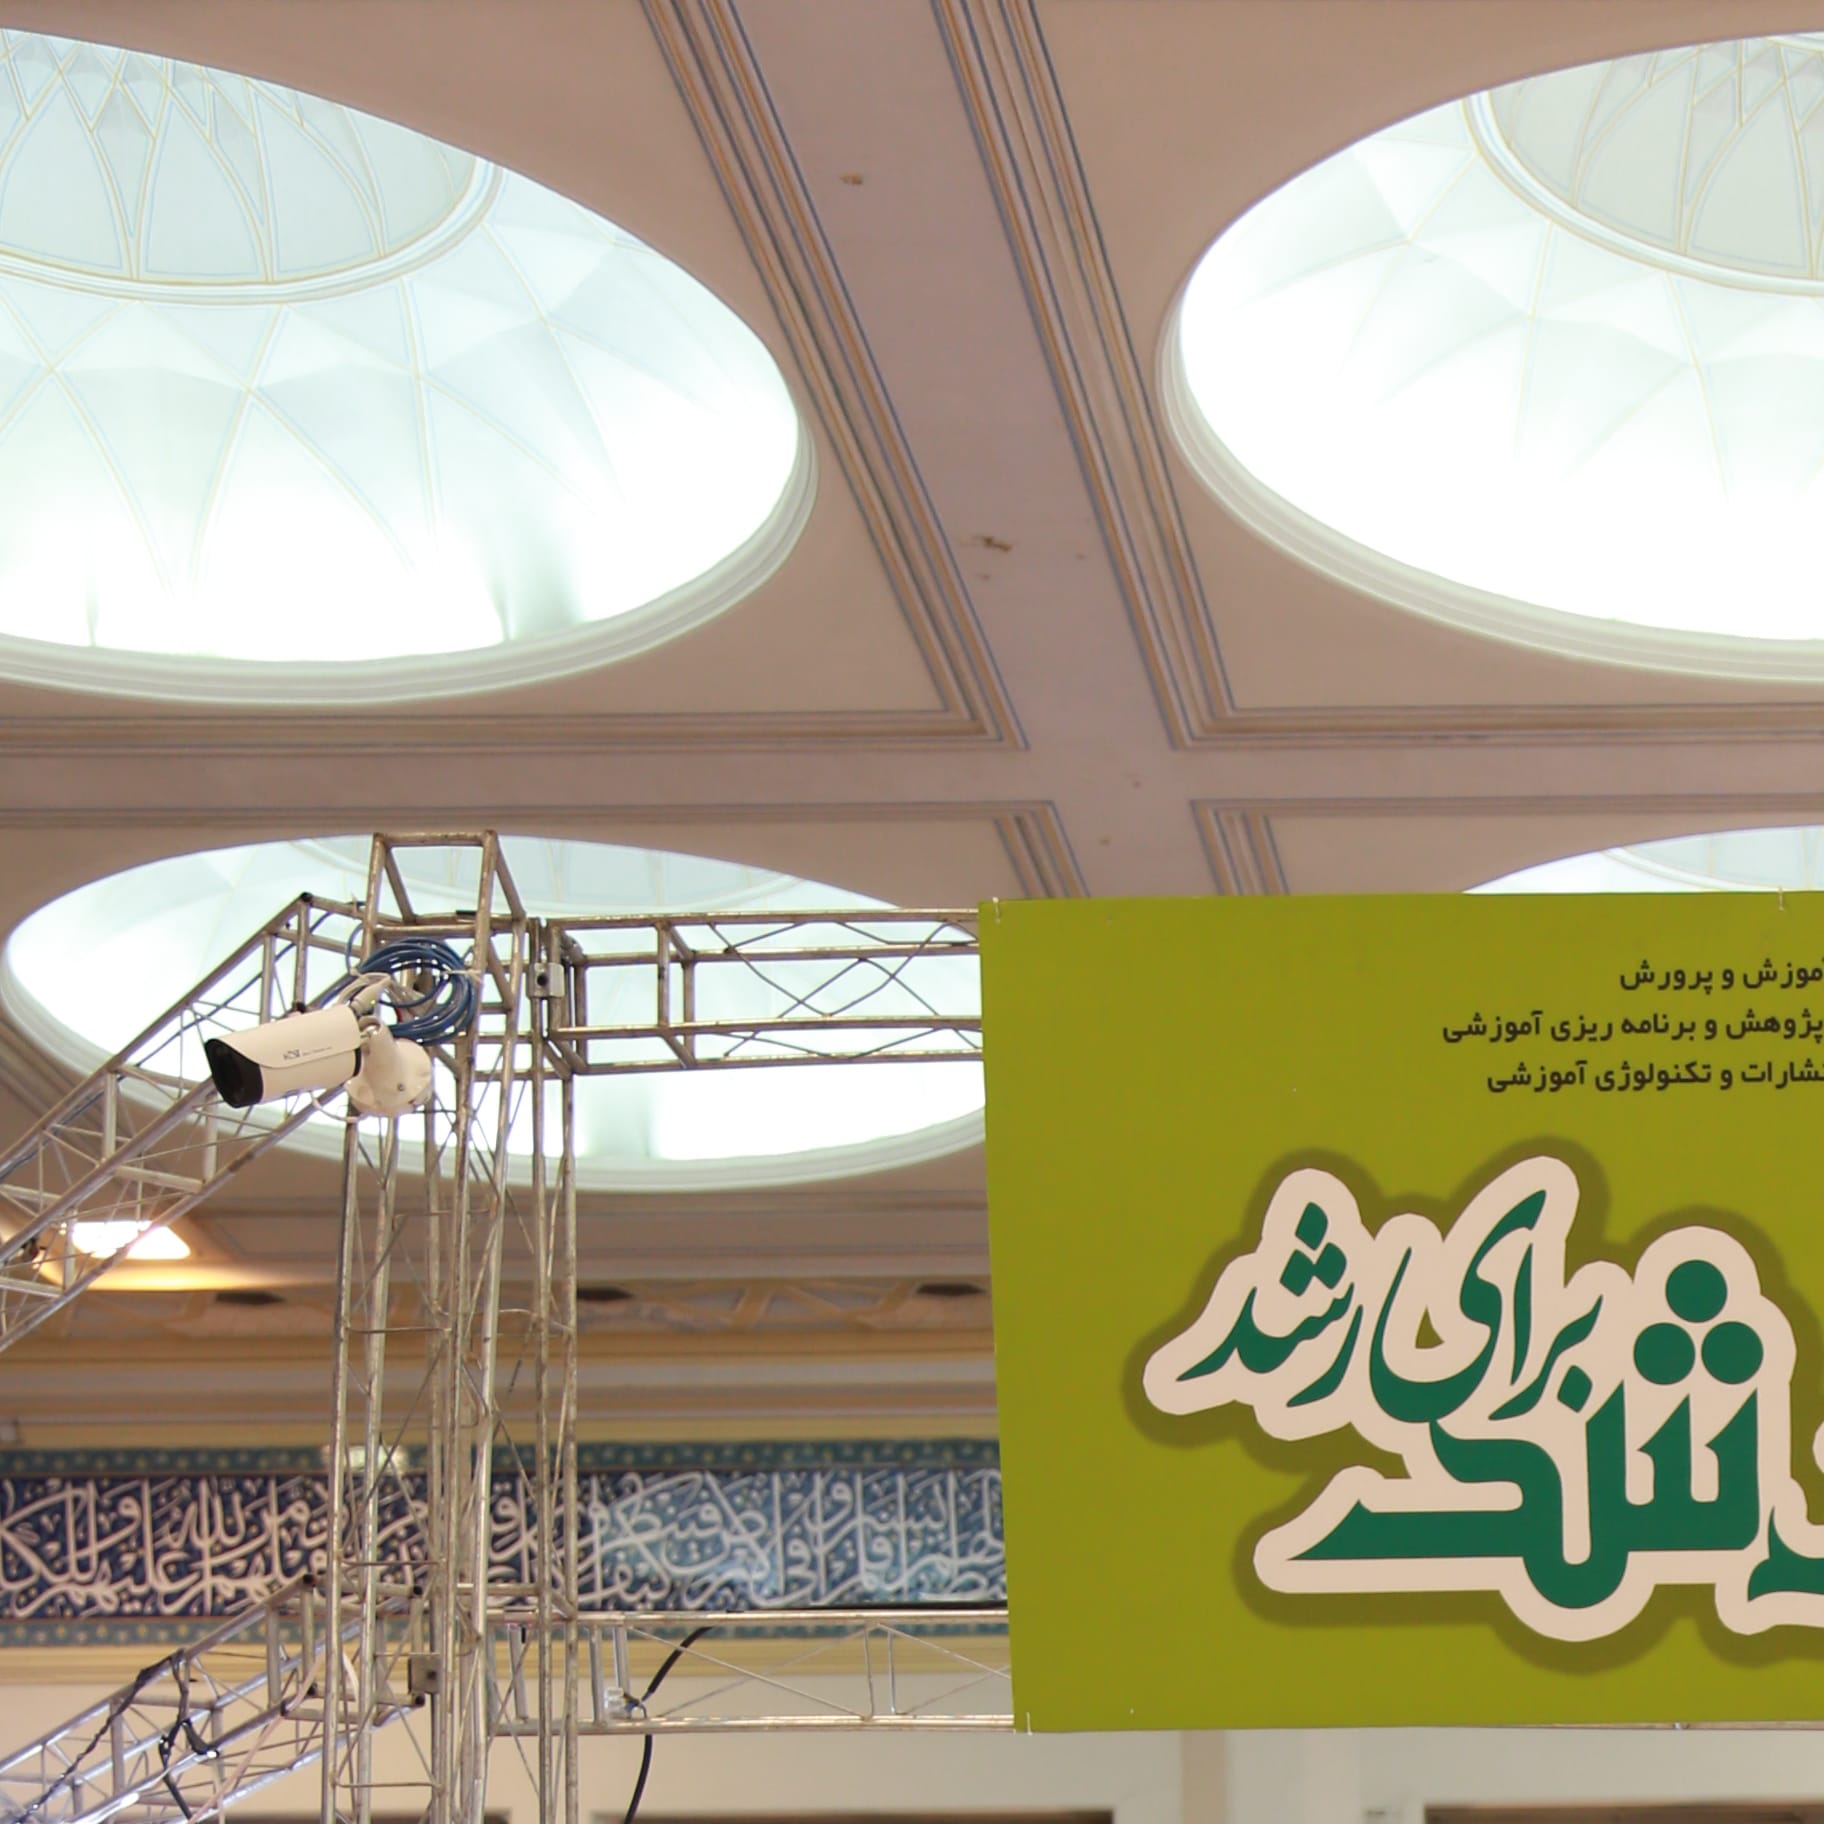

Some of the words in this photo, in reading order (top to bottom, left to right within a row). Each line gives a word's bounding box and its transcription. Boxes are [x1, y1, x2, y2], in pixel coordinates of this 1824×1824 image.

[1619, 959, 1713, 995] پرورش
[1721, 968, 1735, 990] و
[1442, 1009, 1544, 1043] آموزشی
[1550, 1015, 1613, 1042] ریزی
[1620, 1012, 1696, 1041] برنامه
[1703, 1018, 1718, 1041] و
[1725, 1007, 1824, 1044] پژوهش
[1487, 1059, 1588, 1093] آموزشی
[1594, 1060, 1712, 1092] تکنولوژی
[1719, 1069, 1733, 1091] و
[1175, 1201, 1364, 1408] رشد
[1368, 1188, 1605, 1423] برای
